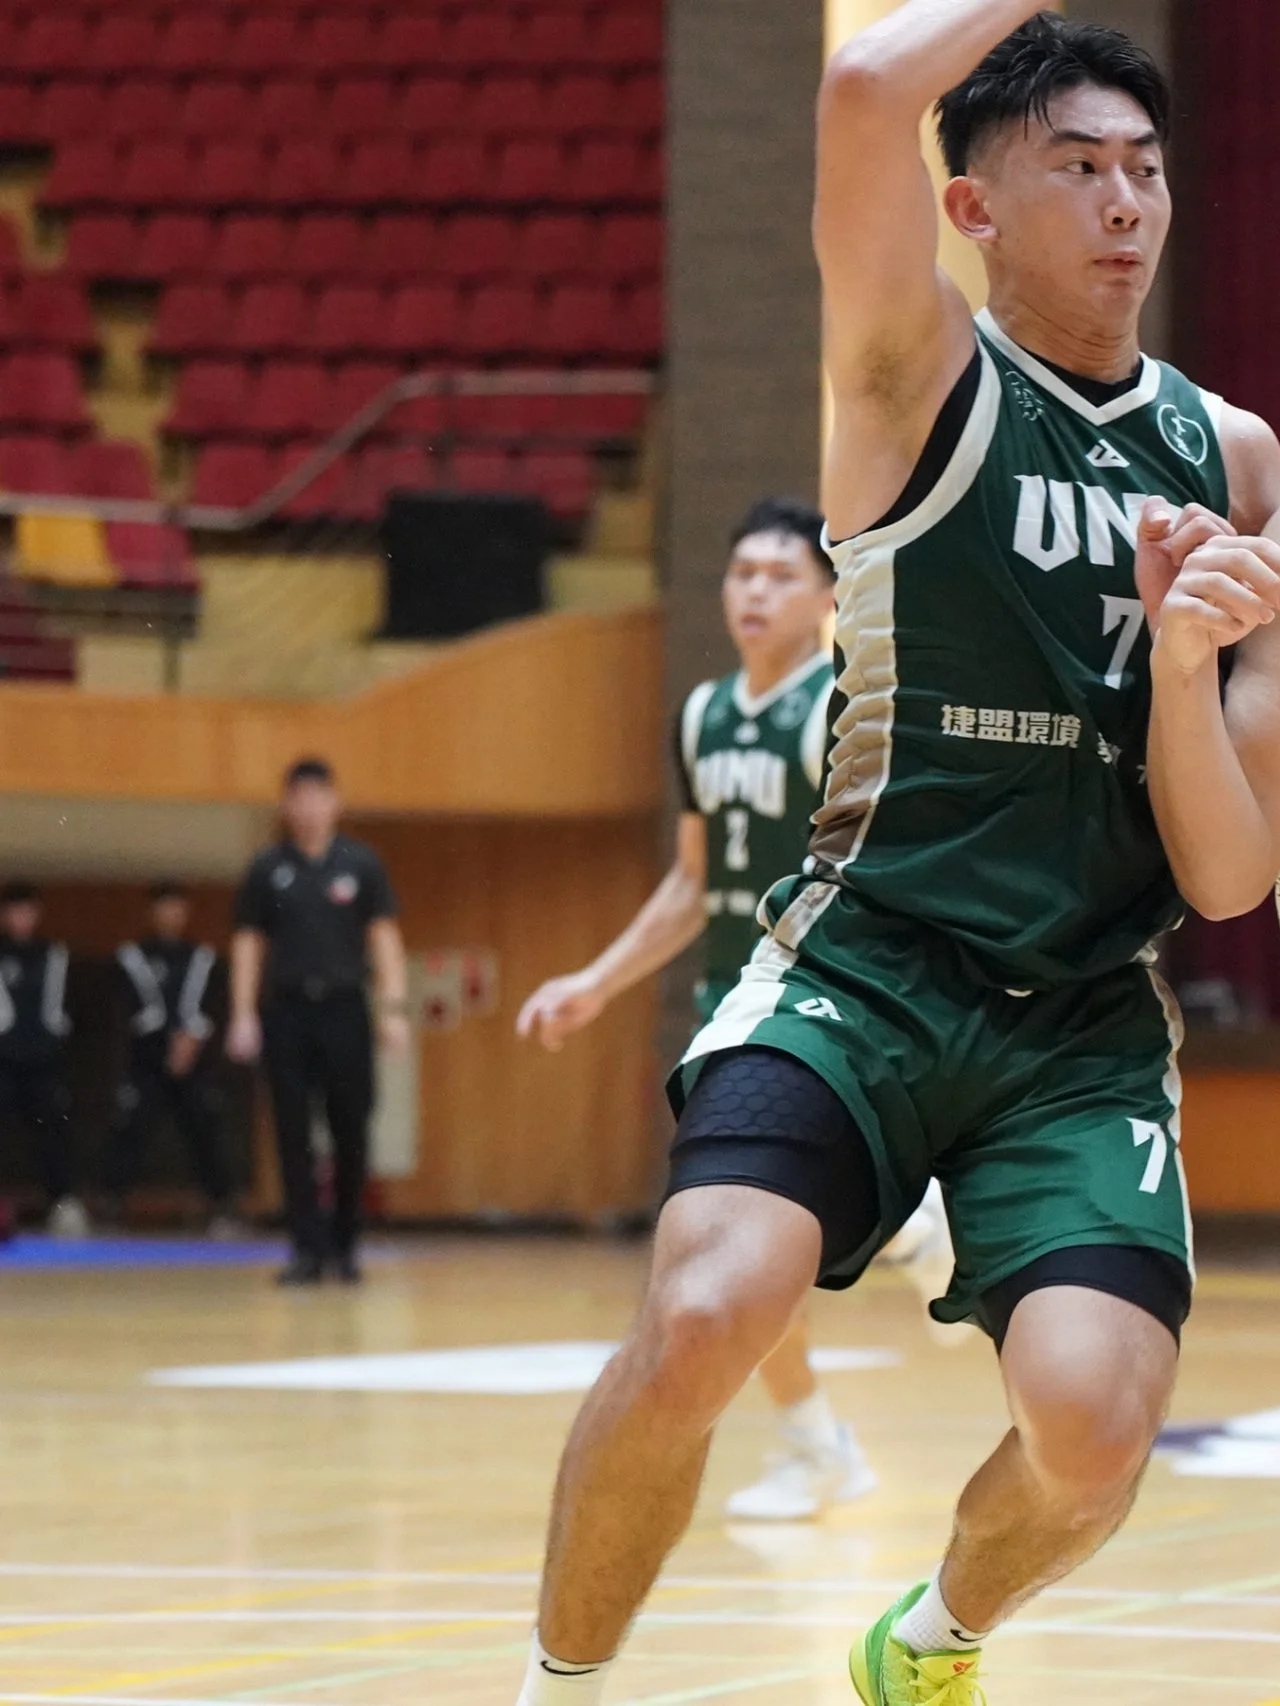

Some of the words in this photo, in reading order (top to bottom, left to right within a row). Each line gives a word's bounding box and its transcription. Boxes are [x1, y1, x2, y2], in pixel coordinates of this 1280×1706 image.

[1099, 593, 1146, 690] 7
[941, 704, 1082, 749] 捷盟環境
[1125, 1116, 1168, 1195] 7
